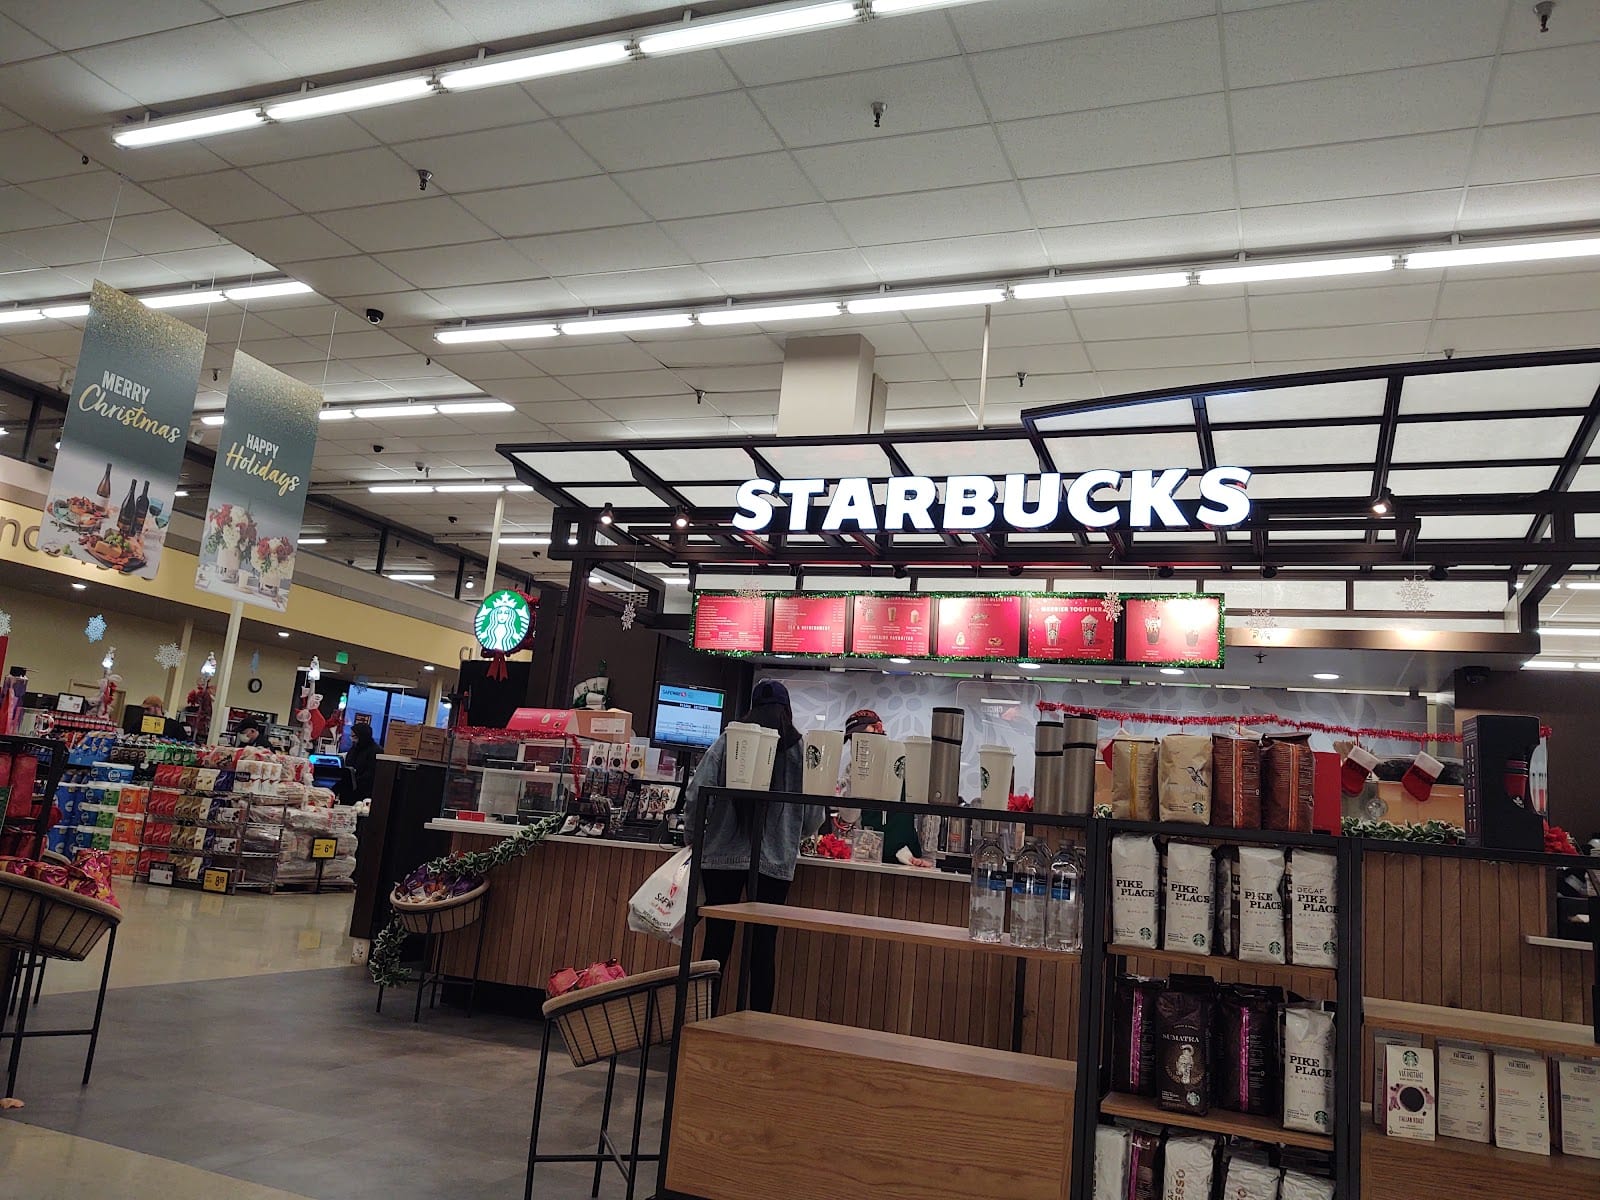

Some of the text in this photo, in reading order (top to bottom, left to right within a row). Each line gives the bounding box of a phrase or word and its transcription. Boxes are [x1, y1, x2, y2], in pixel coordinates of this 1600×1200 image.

[101, 370, 150, 404] MERRY
[78, 383, 181, 444] Christmas
[246, 433, 279, 459] HAPPY
[226, 442, 301, 497] Holidays
[731, 466, 1253, 532] STARBUCKS
[1116, 879, 1143, 889] PIKE
[1170, 883, 1199, 894] PIKE
[1121, 888, 1155, 897] PLACE
[1175, 892, 1210, 904] PLACE
[1244, 891, 1273, 901] PIKE
[1249, 900, 1282, 910] PLACE
[1297, 894, 1328, 904] PIKE
[1162, 1033, 1200, 1043] SUMATRA
[1289, 1055, 1320, 1067] PIKE
[1295, 1065, 1332, 1078] PLACE
